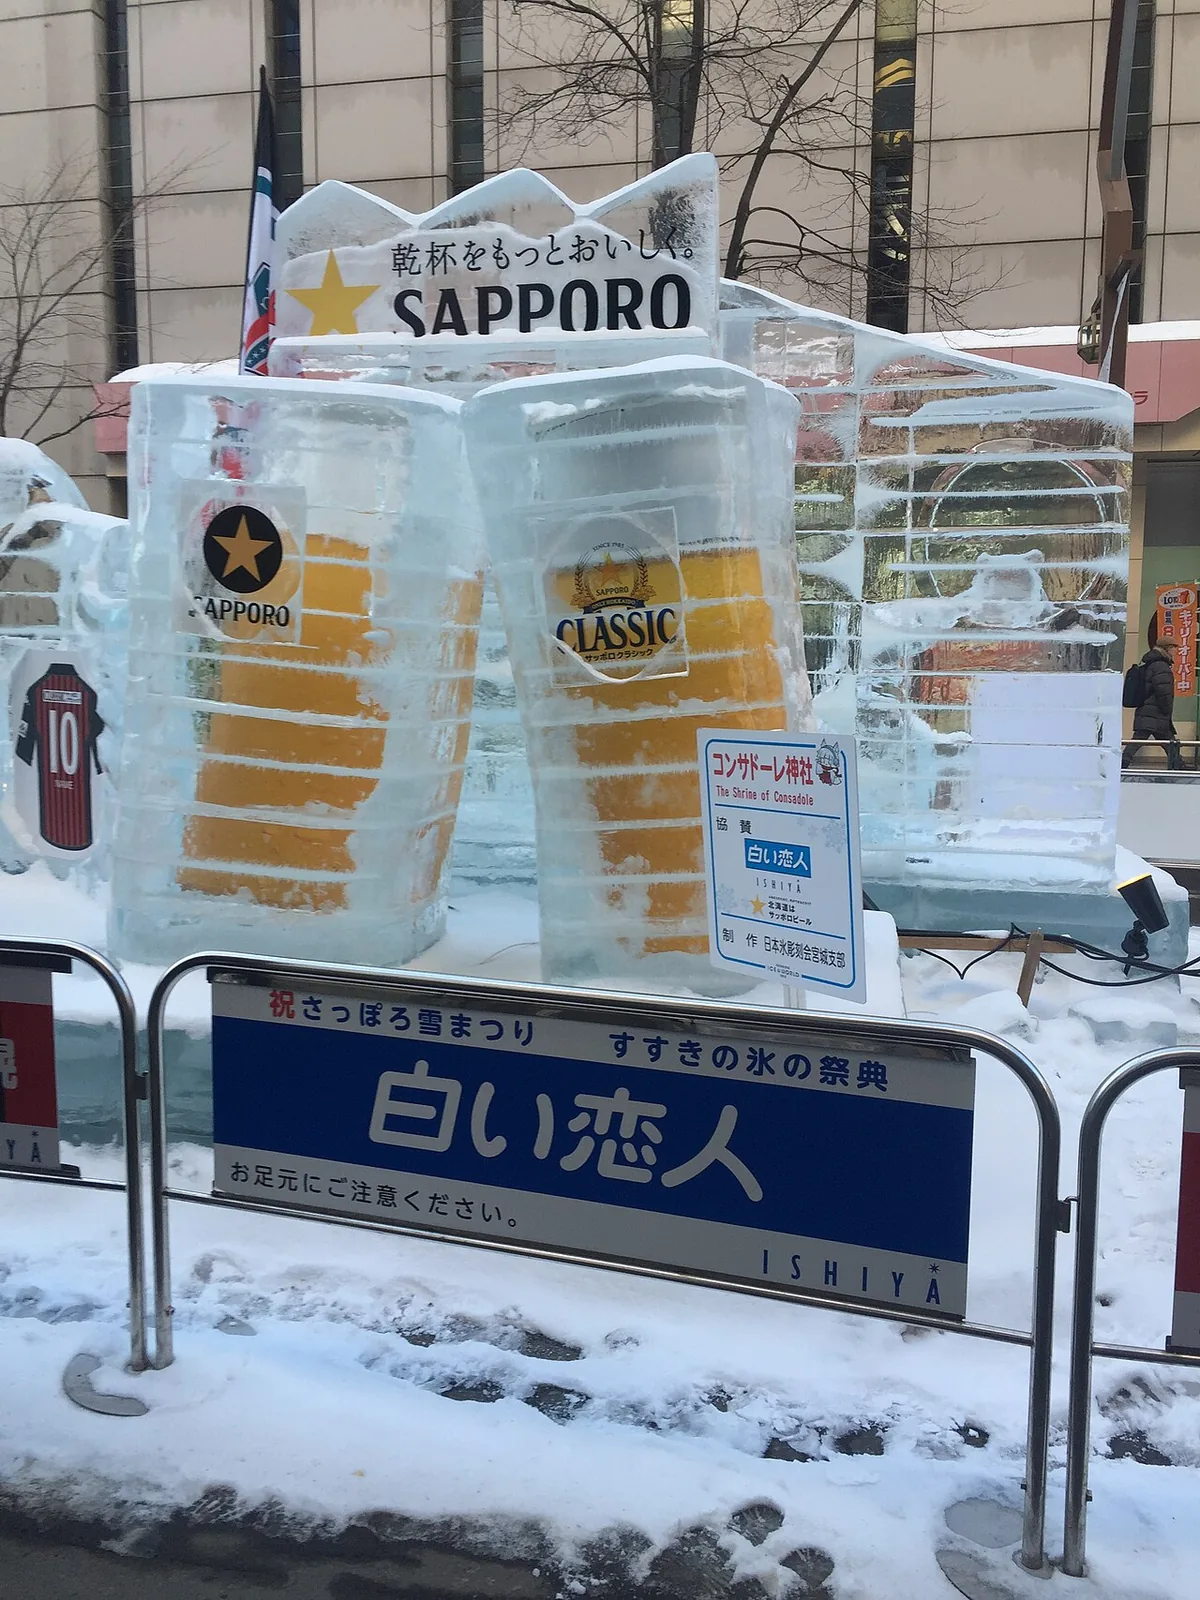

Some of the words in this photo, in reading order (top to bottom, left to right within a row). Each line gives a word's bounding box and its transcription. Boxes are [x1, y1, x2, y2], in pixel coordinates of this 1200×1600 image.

[391, 226, 694, 278] 乾杯をもっとおいしく。
[394, 274, 692, 338] SAPPORO
[595, 586, 629, 596] SAPPORO
[555, 608, 678, 655] CLASSIC
[584, 648, 654, 662] サッポロクラシック
[1177, 609, 1193, 692] キャリーオーバー中
[48, 709, 79, 775] 10
[712, 752, 814, 786] コンサドーレ神社
[716, 785, 730, 797] The
[732, 787, 757, 800] Shrine
[760, 790, 770, 801] of
[773, 791, 814, 806] Consadole
[747, 844, 808, 871] 白い恋人
[756, 877, 801, 894] ISHIYA
[769, 911, 812, 926] サッポロビール
[609, 1031, 889, 1092] すすきの氷の祭典
[368, 1059, 764, 1202] 白い恋人
[230, 1160, 518, 1228] お足元にご注意ください。
[762, 1248, 942, 1305] ISHIYA
